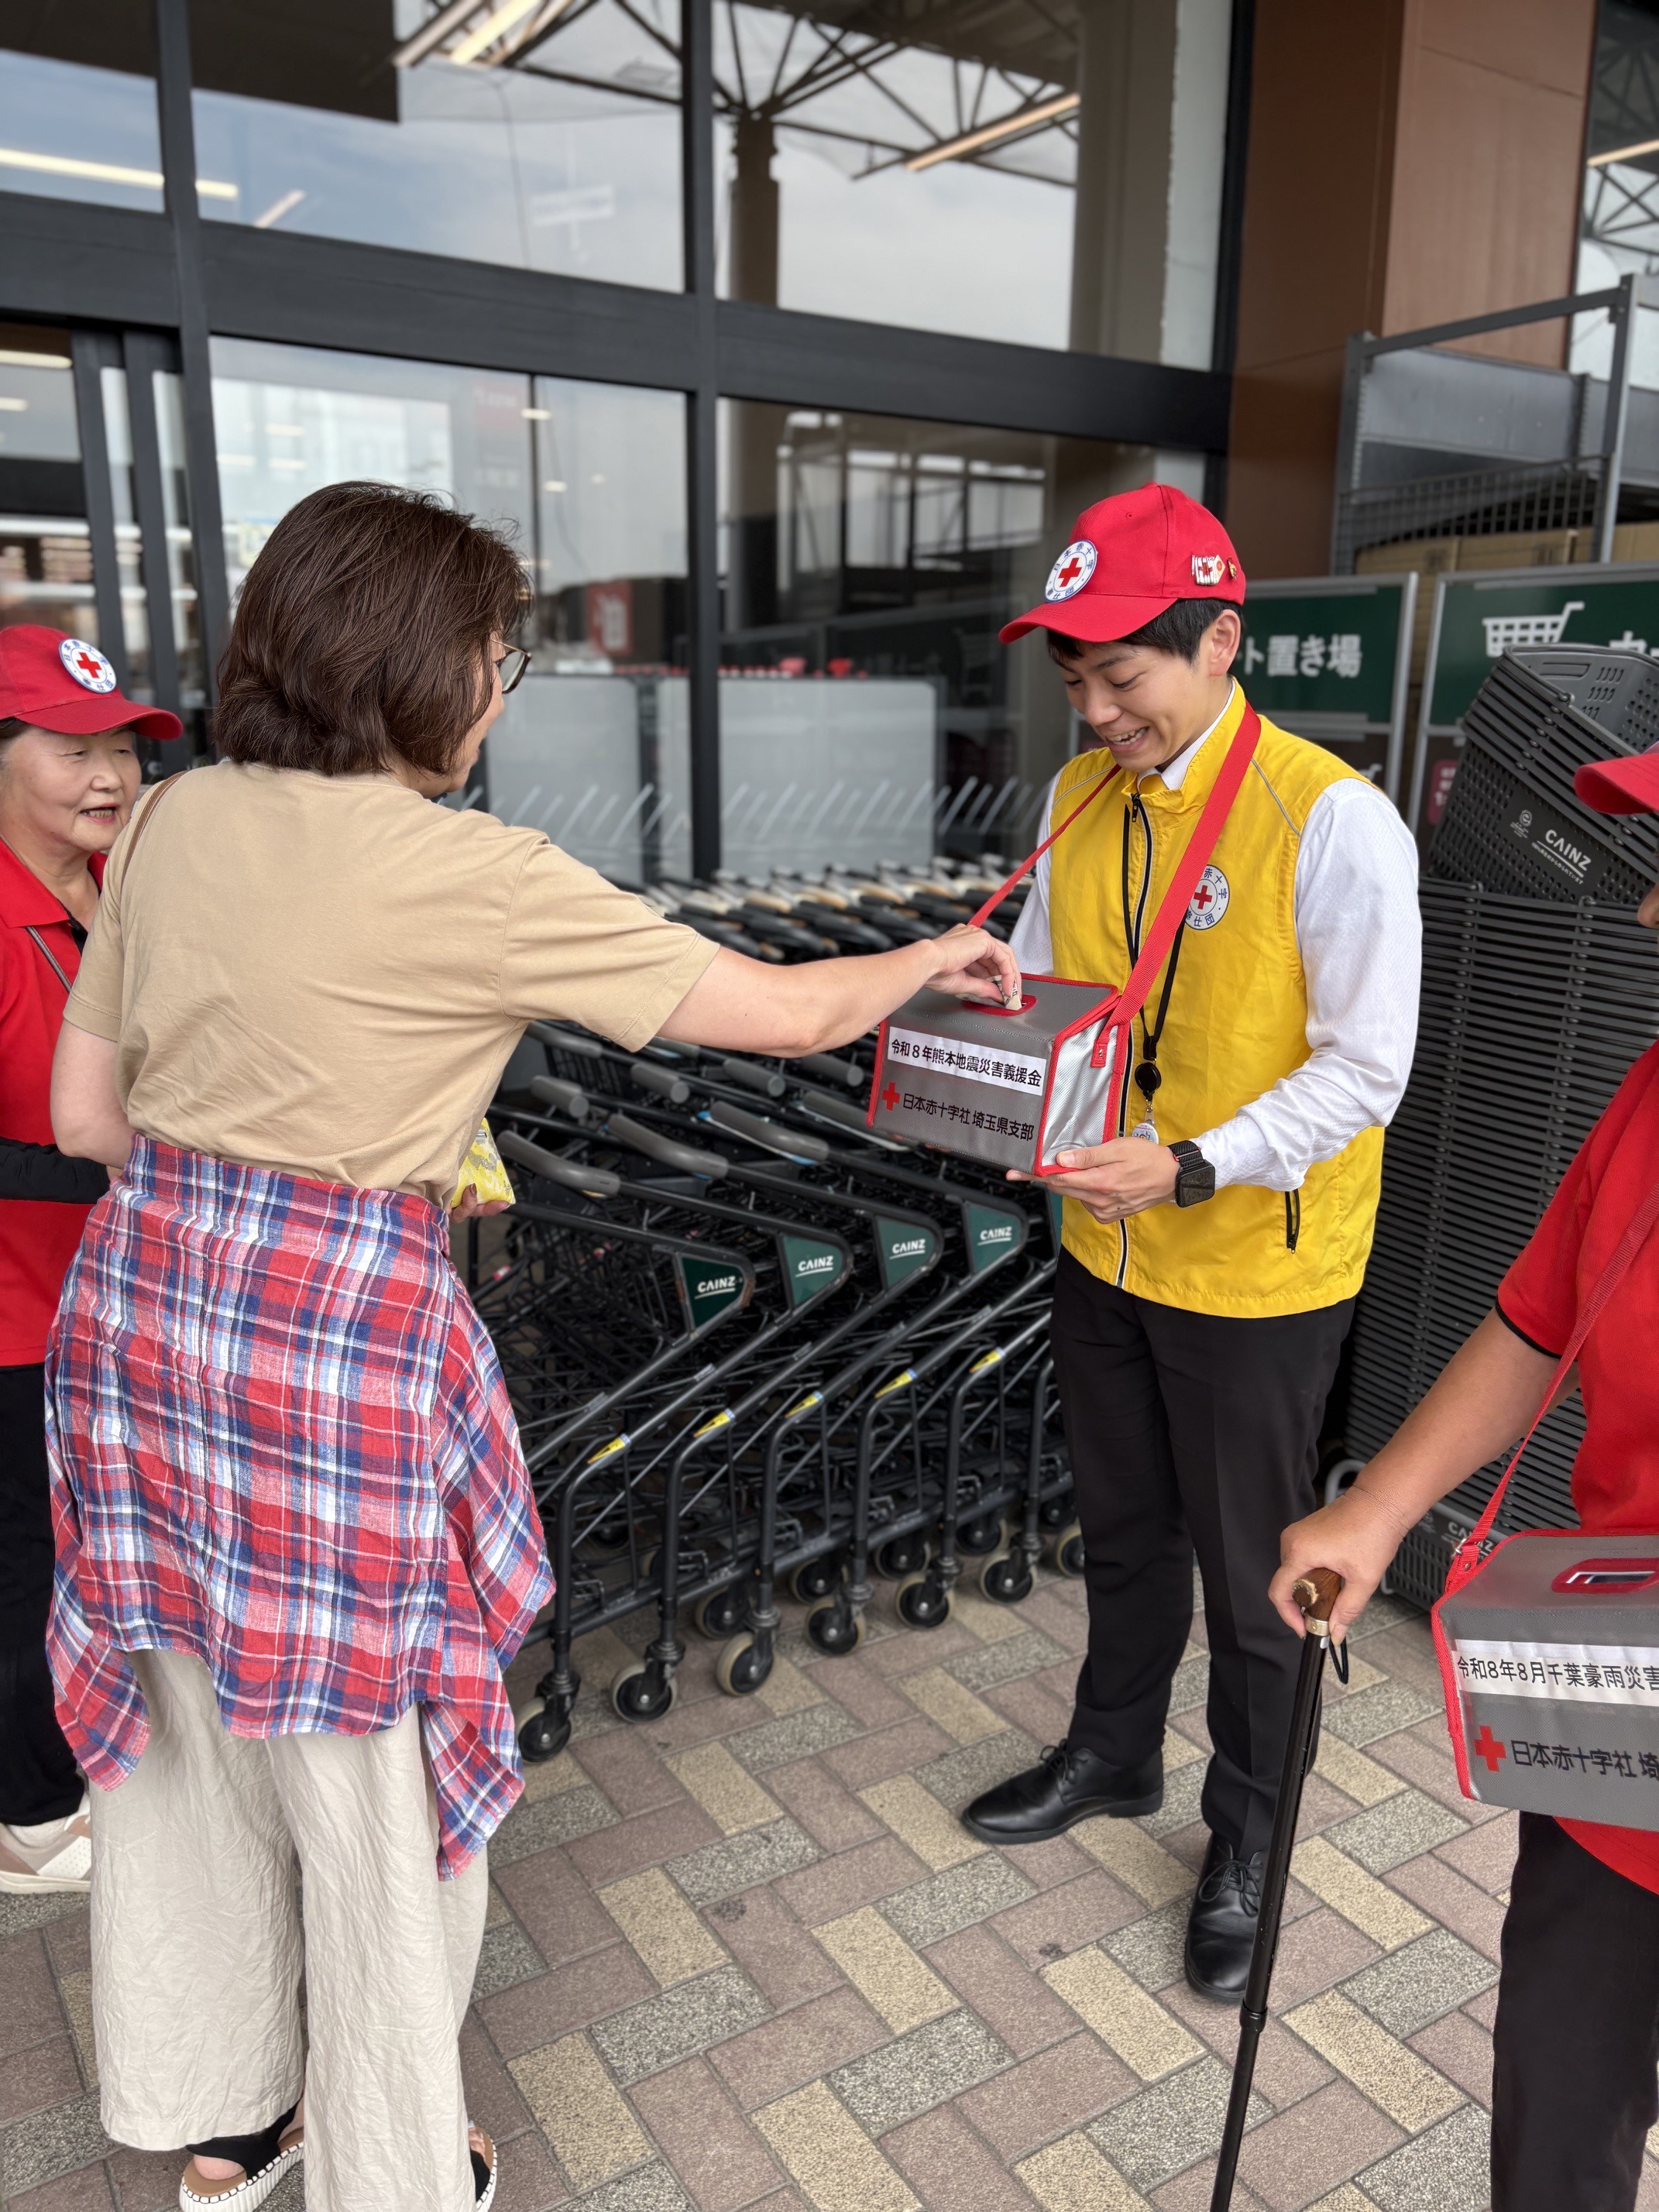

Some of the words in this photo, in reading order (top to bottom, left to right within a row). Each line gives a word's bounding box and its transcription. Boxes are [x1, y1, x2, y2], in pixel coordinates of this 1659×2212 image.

[1238, 634, 1363, 678] ト置き場
[1545, 829, 1592, 871] CAINZ
[903, 1093, 970, 1125] 日本赤十字社
[972, 1110, 1035, 1142] 埼玉県支部
[892, 1239, 926, 1254] CAINZ
[980, 1226, 1012, 1241] CAINZ
[798, 1255, 833, 1272] CAINZ
[697, 1276, 736, 1293] CAINZ
[1448, 1522, 1494, 1552] CAZ
[1457, 1658, 1659, 1692] 令和8年8月千葉豪雨災害
[1511, 1740, 1637, 1778] 日本赤十字社
